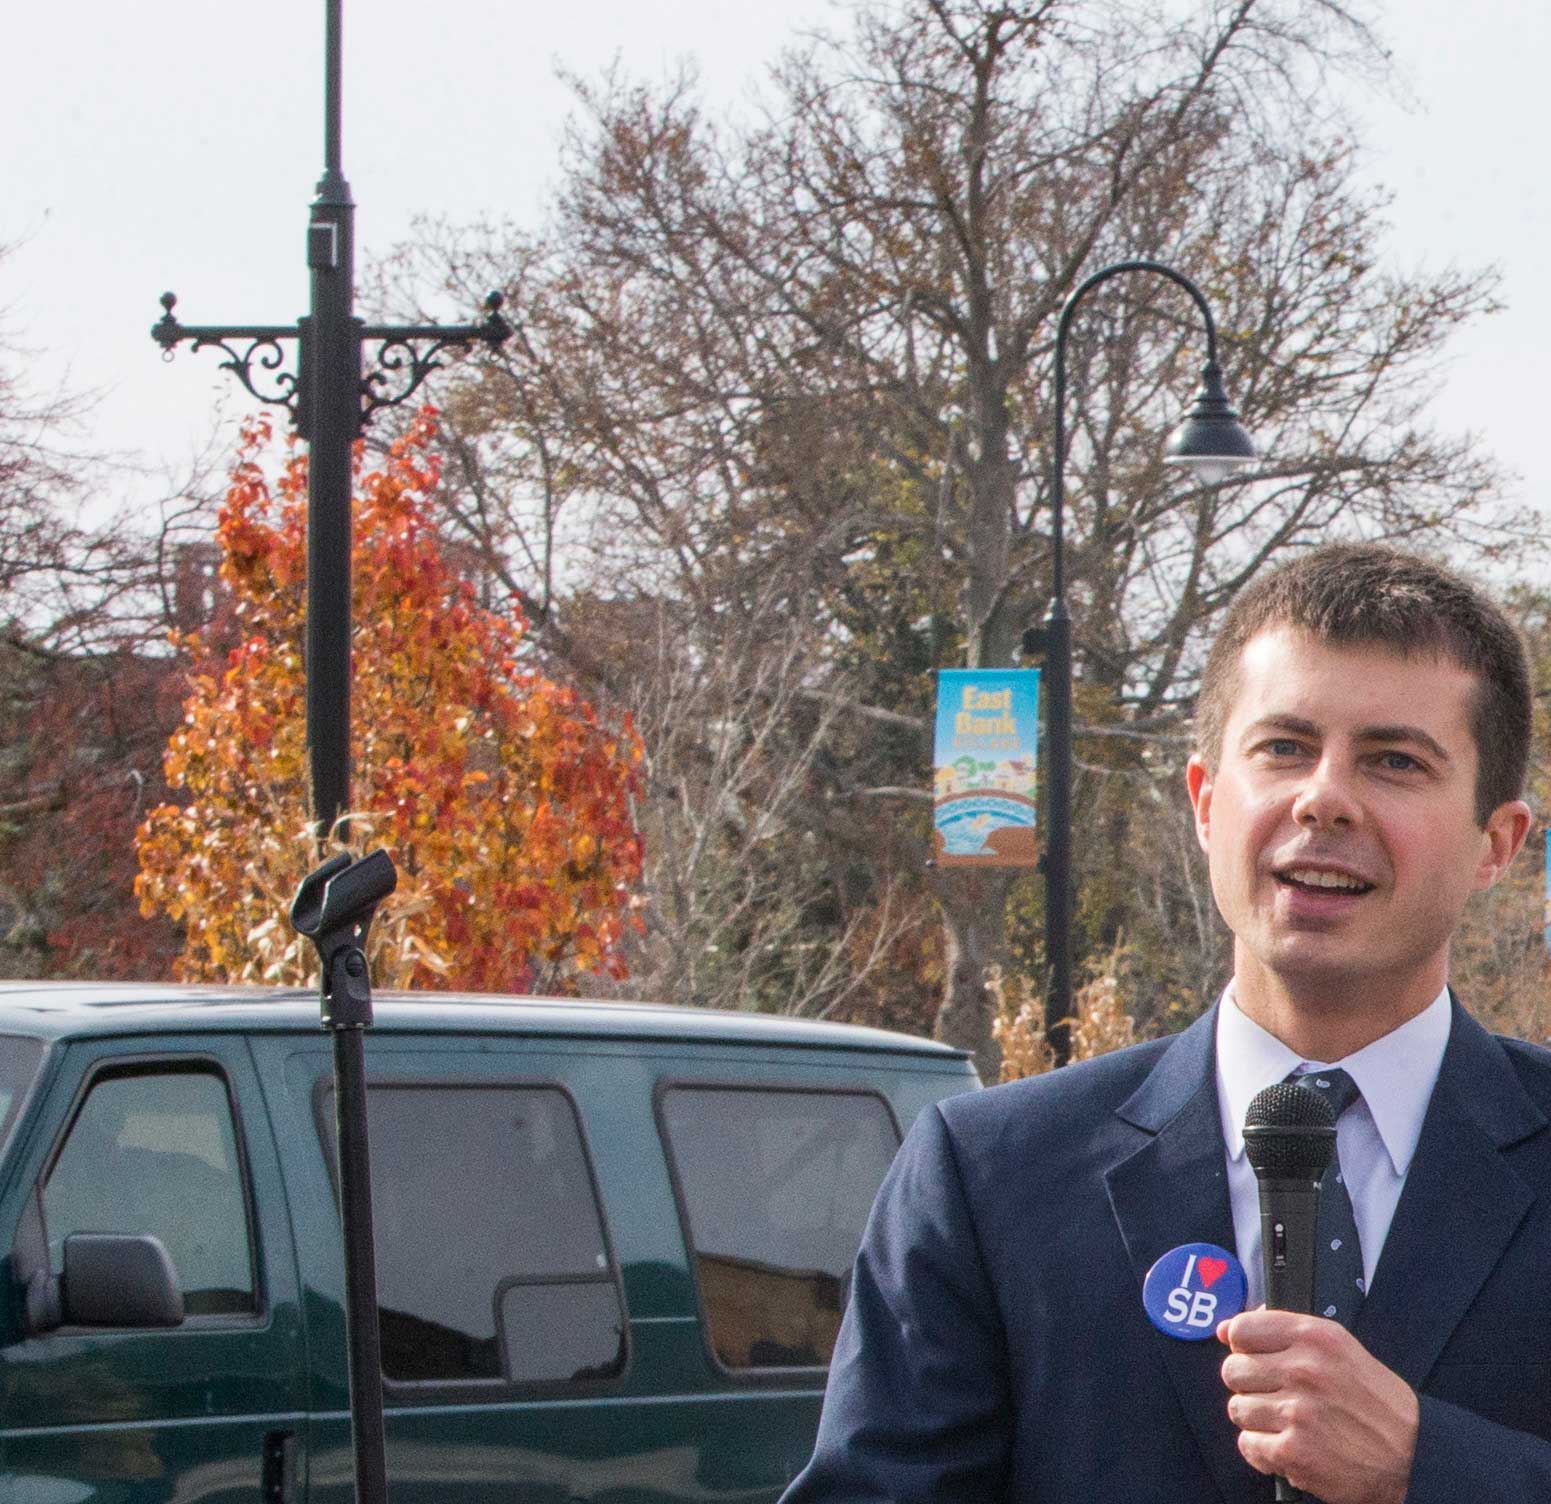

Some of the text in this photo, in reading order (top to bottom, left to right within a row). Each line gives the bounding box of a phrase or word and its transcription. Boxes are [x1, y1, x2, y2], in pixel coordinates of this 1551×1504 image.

[962, 685, 1012, 711] East
[955, 711, 1016, 735] Bank
[1181, 1253, 1197, 1288] I
[1163, 1287, 1218, 1328] SB
